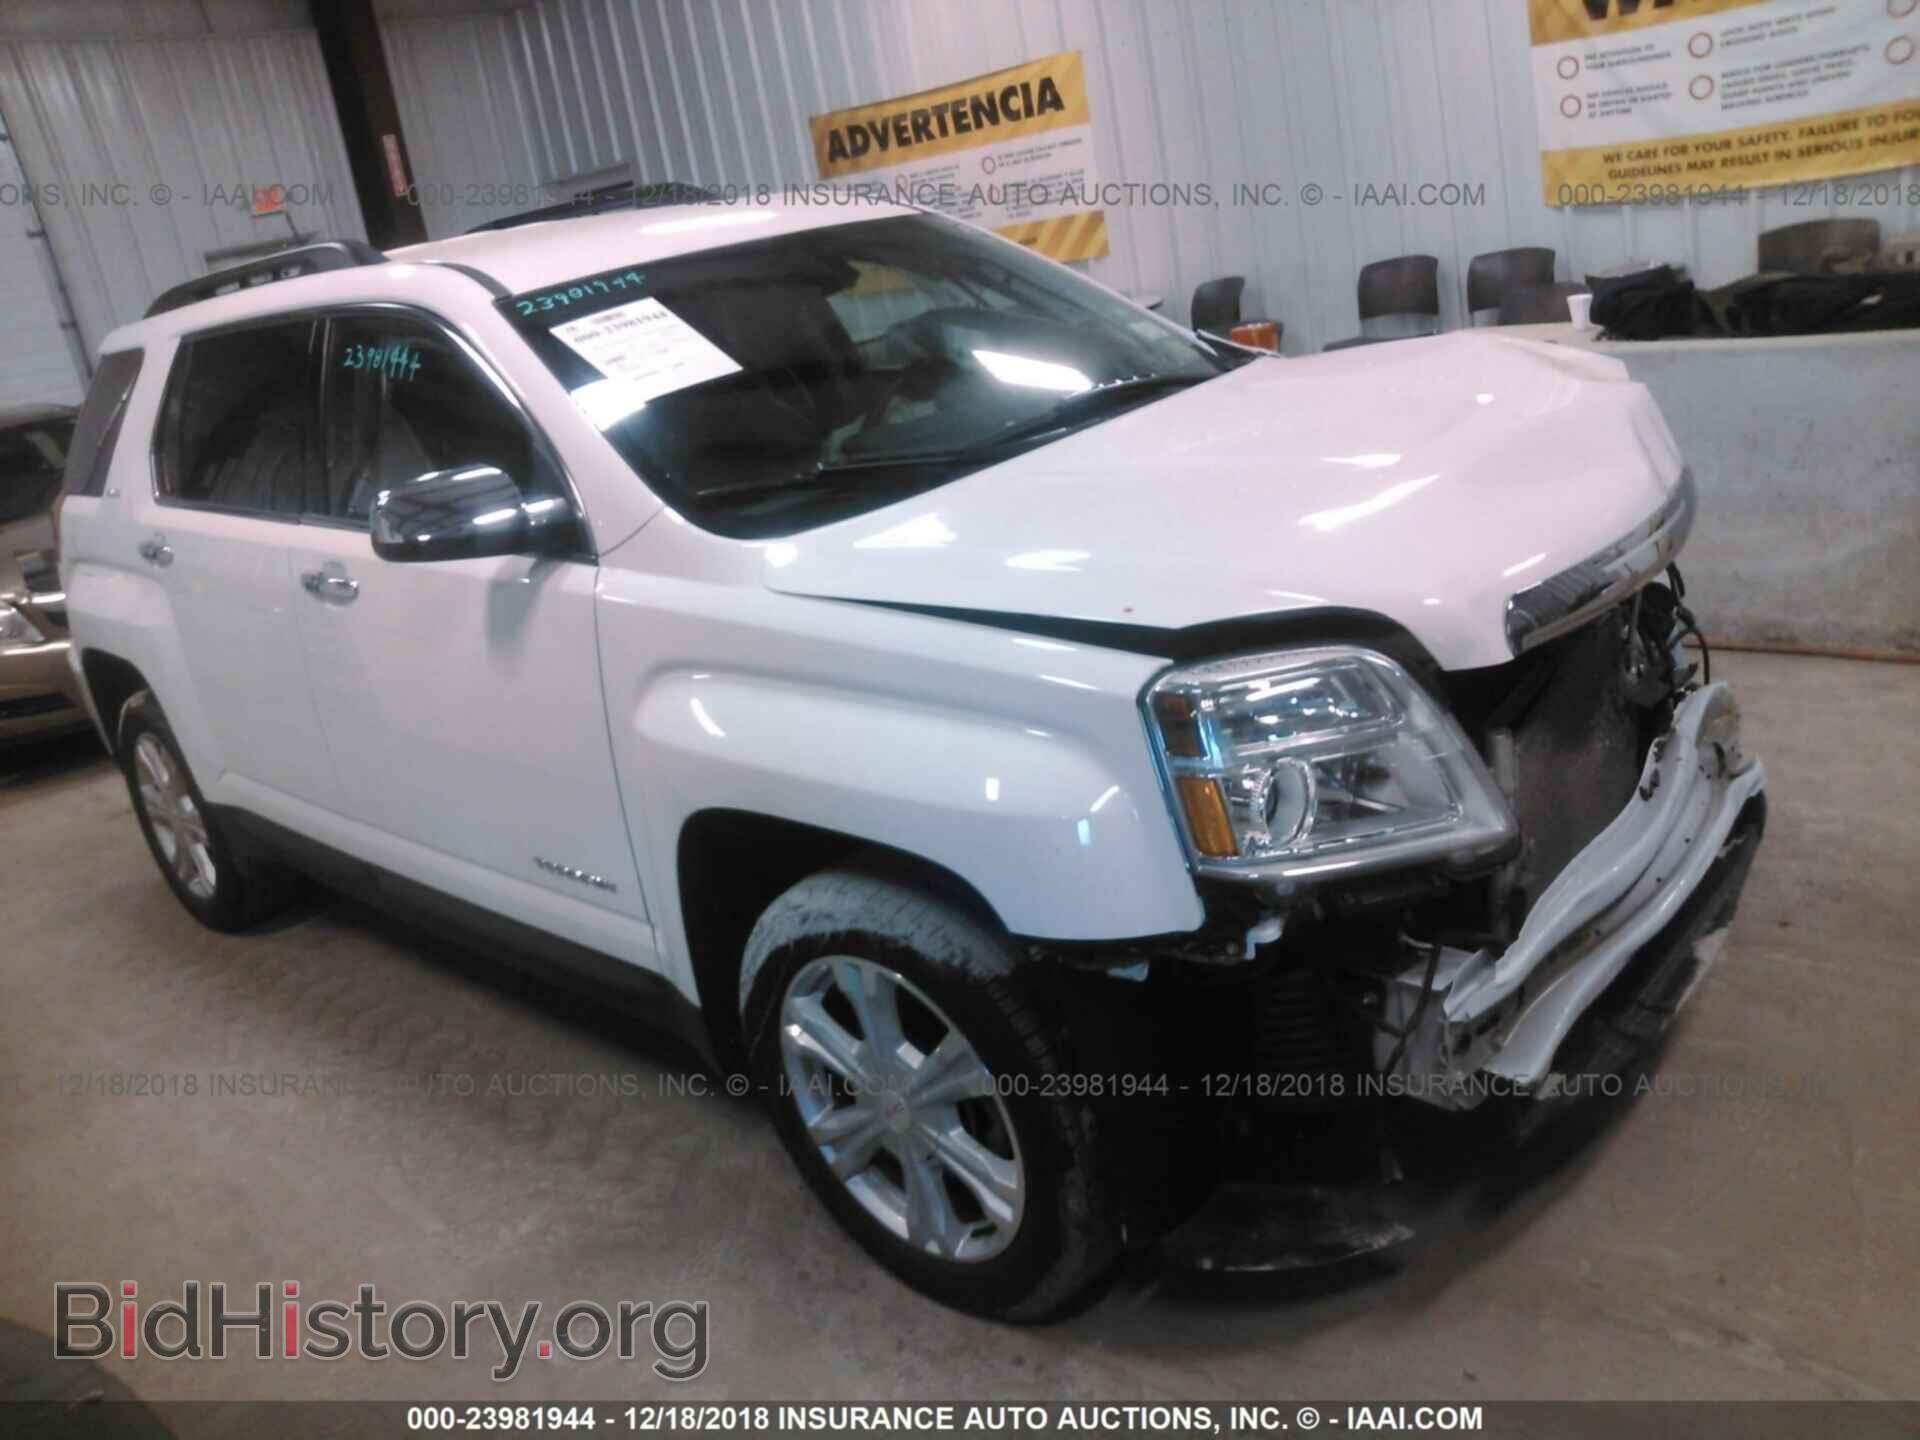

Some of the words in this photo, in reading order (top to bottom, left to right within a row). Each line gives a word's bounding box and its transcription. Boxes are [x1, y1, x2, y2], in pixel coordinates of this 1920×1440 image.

[828, 77, 1065, 163] ADVERTENCIA
[1602, 152, 1622, 164] WE
[1626, 148, 1658, 161] CARE
[1664, 143, 1689, 157] FOR
[1694, 138, 1732, 153] YOUR
[1608, 163, 1682, 180] GUIDELINES
[1686, 159, 1714, 171] MAY
[1720, 151, 1769, 168] RESULT
[1774, 148, 1792, 163] IN
